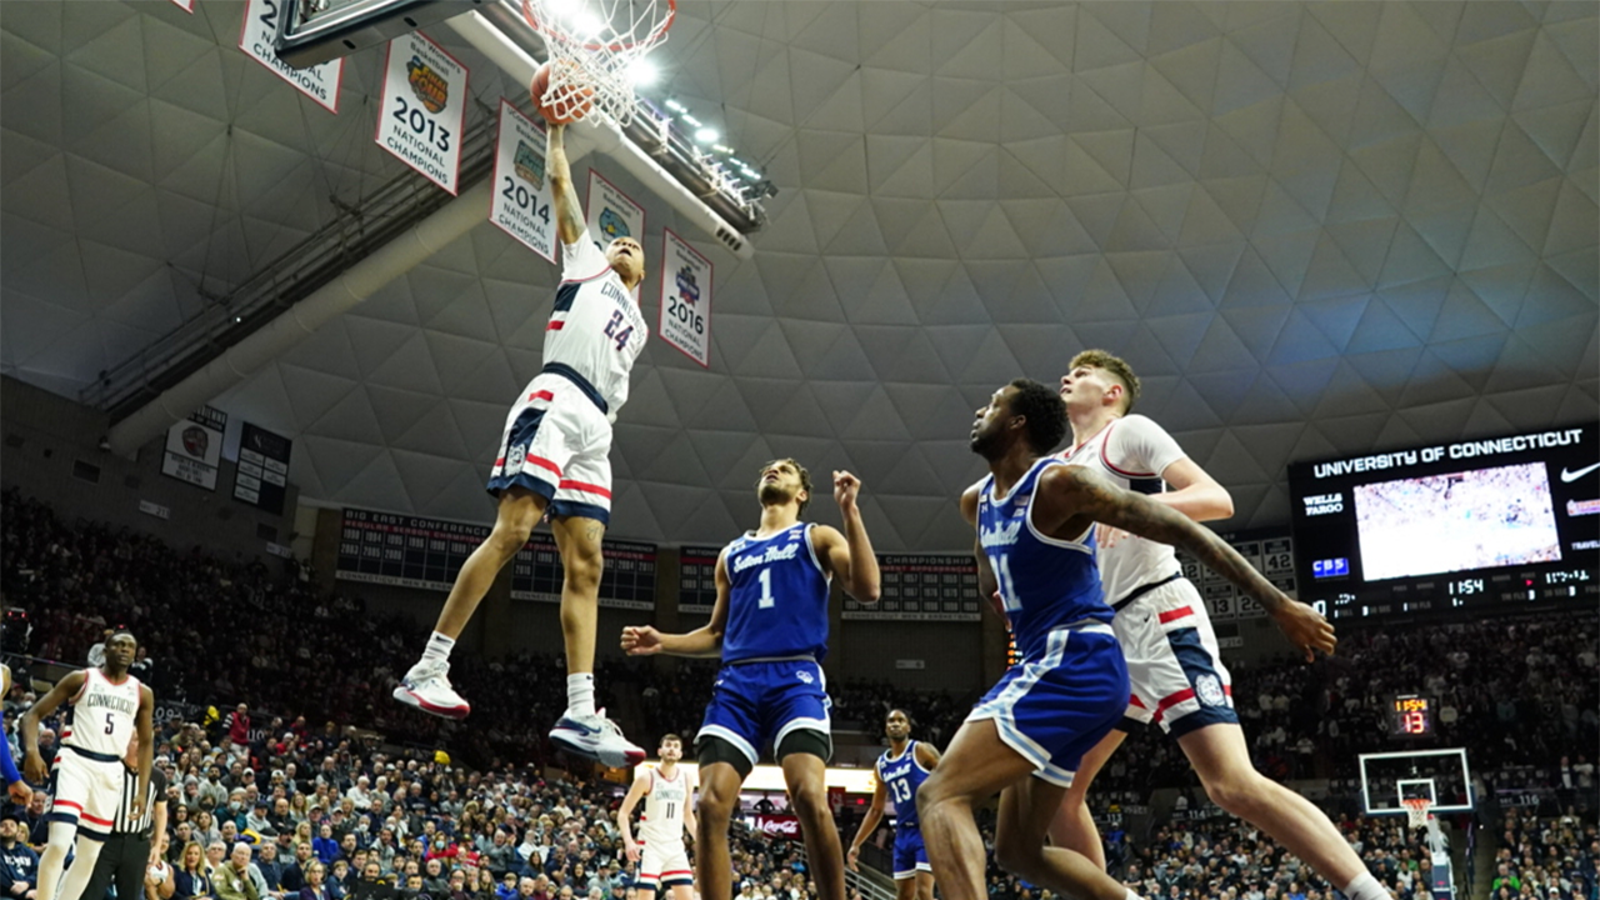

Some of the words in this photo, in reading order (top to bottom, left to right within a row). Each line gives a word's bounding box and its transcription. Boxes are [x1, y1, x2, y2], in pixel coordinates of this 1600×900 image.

[253, 43, 327, 100] CHAMPIONS
[411, 42, 450, 77] Basketball
[393, 96, 451, 153] 2013
[394, 124, 445, 169] NATIONAL
[387, 136, 448, 185] CHAMPIONS
[502, 176, 550, 221] 2014
[504, 202, 547, 240] NATIONAL
[499, 213, 550, 256] CHAMPIONS
[668, 295, 704, 335] 2016
[603, 309, 634, 352] 24
[669, 319, 701, 348] NATIONAL
[665, 329, 703, 361] CHAMPIONS
[1314, 450, 1417, 478] UNIVERSITY
[1421, 446, 1445, 463] OF
[1449, 429, 1583, 459] CONNECTICUT
[1303, 493, 1343, 506] WELLS
[1305, 503, 1344, 516] FARGO
[345, 510, 367, 521] BIG
[372, 513, 405, 525] EAST
[410, 519, 489, 537] CONFERENCE
[433, 530, 487, 545] CHAMPION
[885, 556, 972, 566] CHAMPIONSHIP
[1268, 553, 1291, 570] 42
[1313, 558, 1345, 572] CBS
[758, 567, 775, 610] 1
[1448, 578, 1486, 596] 11:54
[1211, 599, 1229, 613] 13
[87, 692, 134, 716] CONNECTICUT
[1395, 699, 1428, 712] 11:54
[104, 712, 115, 736] 5
[1405, 711, 1425, 734] 13
[890, 778, 912, 804] 13
[1519, 794, 1540, 806] 116
[666, 802, 676, 820] 11
[1188, 809, 1206, 820] 114
